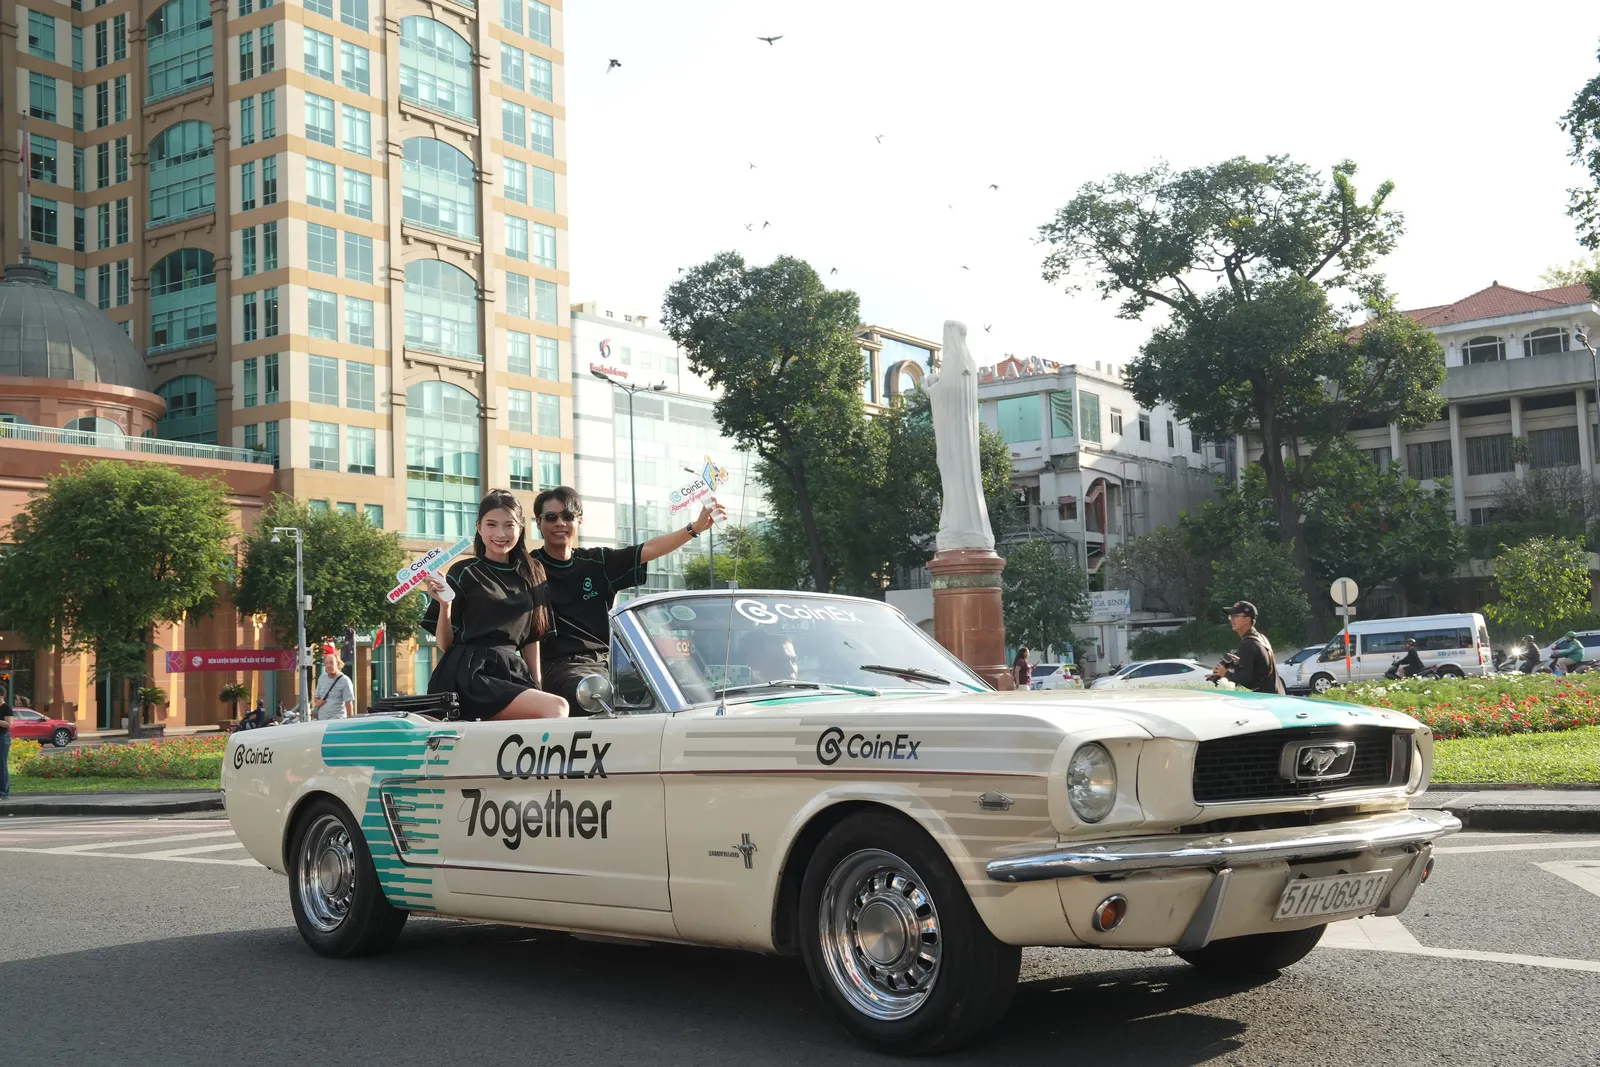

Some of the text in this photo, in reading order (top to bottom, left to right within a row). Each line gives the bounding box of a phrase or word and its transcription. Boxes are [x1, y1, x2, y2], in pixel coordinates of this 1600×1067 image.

[979, 357, 1047, 382] PLAZA
[671, 488, 709, 513] Stronger Together
[681, 480, 706, 496] CoinEx
[410, 548, 441, 571] CoinEx
[389, 583, 410, 600] FOMO
[409, 569, 430, 585] LESS,
[428, 552, 450, 572] KNOW
[775, 604, 864, 623] CoinEx
[245, 747, 274, 764] CoinEx
[497, 731, 612, 780] CoinEx
[847, 734, 921, 760] CoinEx
[1281, 876, 1384, 916] 51H-069.31
